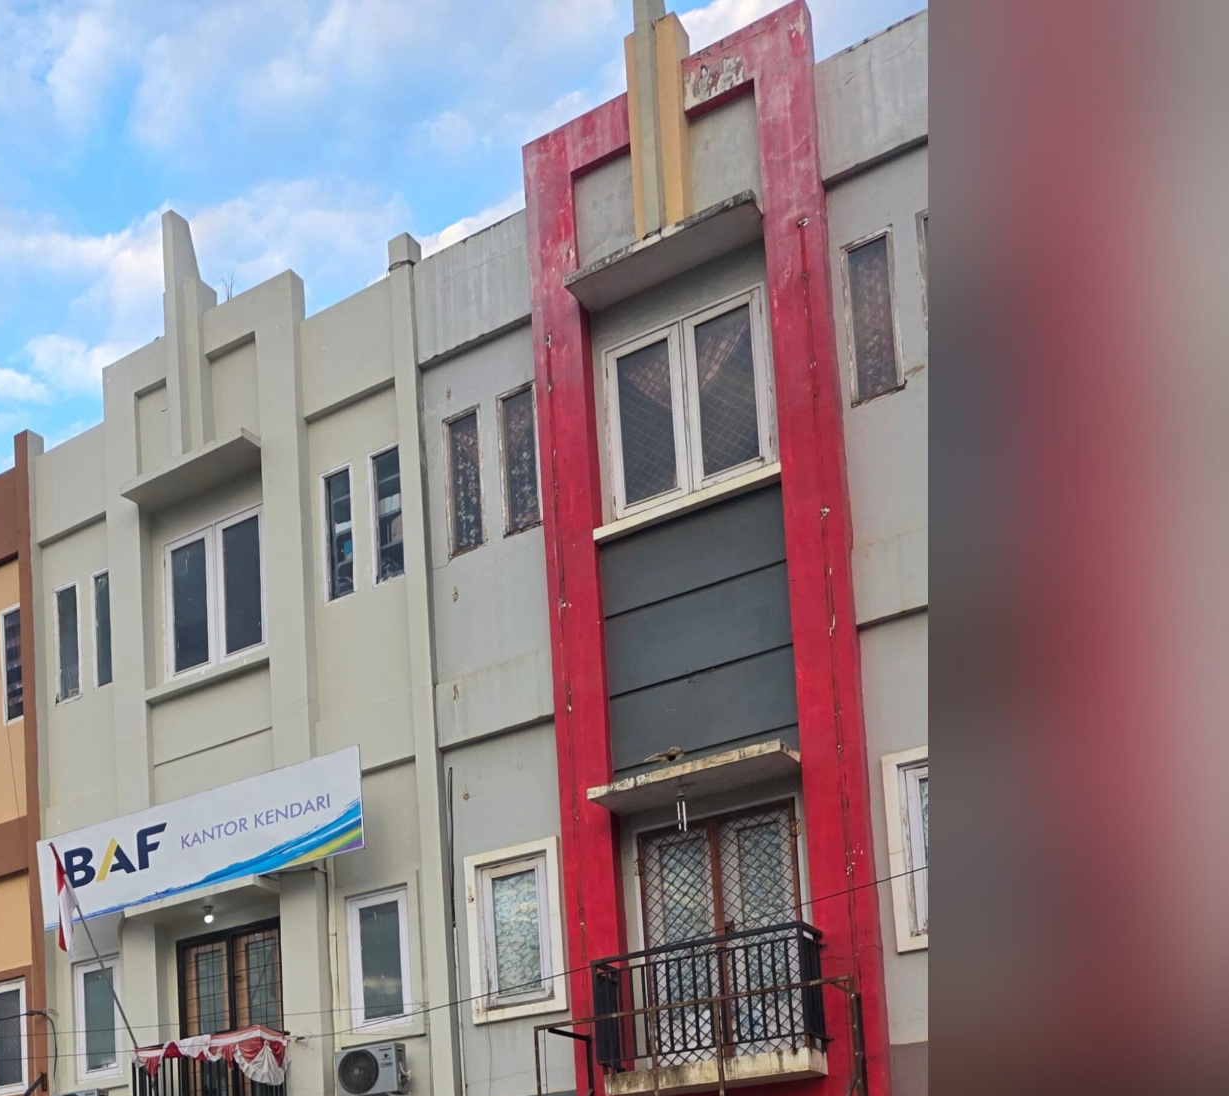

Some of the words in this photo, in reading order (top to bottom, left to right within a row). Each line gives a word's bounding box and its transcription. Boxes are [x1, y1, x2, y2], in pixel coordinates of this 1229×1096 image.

[181, 817, 249, 849] KANTOR
[254, 793, 331, 829] KENDARI
[64, 822, 167, 888] BAF
